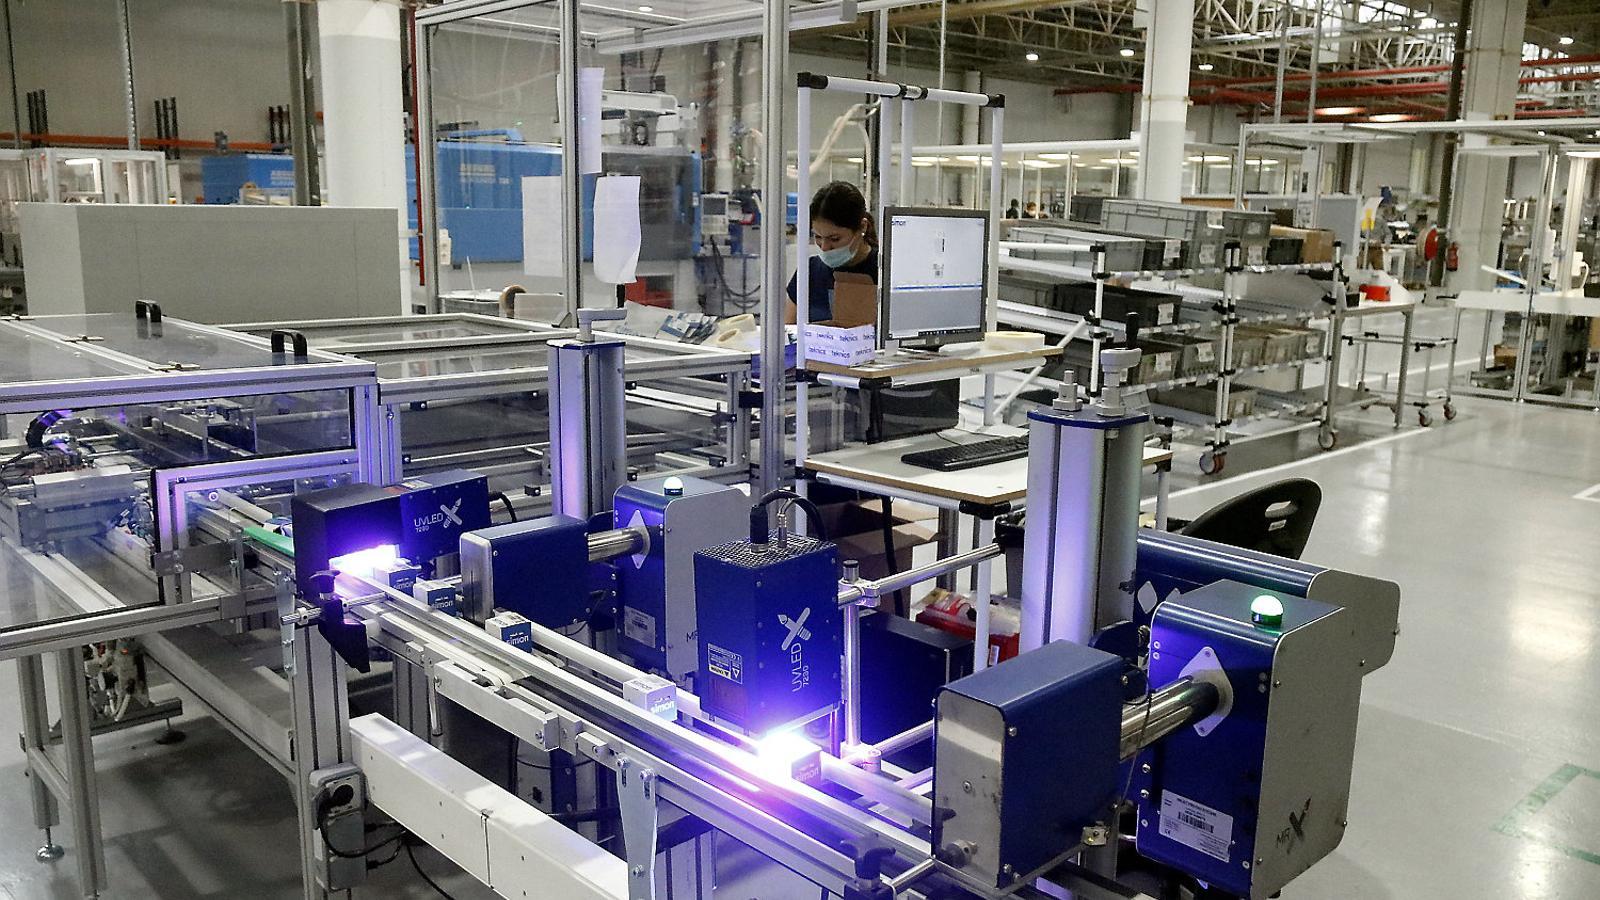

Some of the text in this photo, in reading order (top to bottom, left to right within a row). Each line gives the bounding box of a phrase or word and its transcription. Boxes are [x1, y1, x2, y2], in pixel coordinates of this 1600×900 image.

[839, 333, 858, 343] teknics
[831, 350, 850, 359] teknics
[414, 512, 443, 527] UVLED
[506, 634, 529, 646] simon
[791, 642, 803, 693] UVLED
[650, 699, 675, 714] simon
